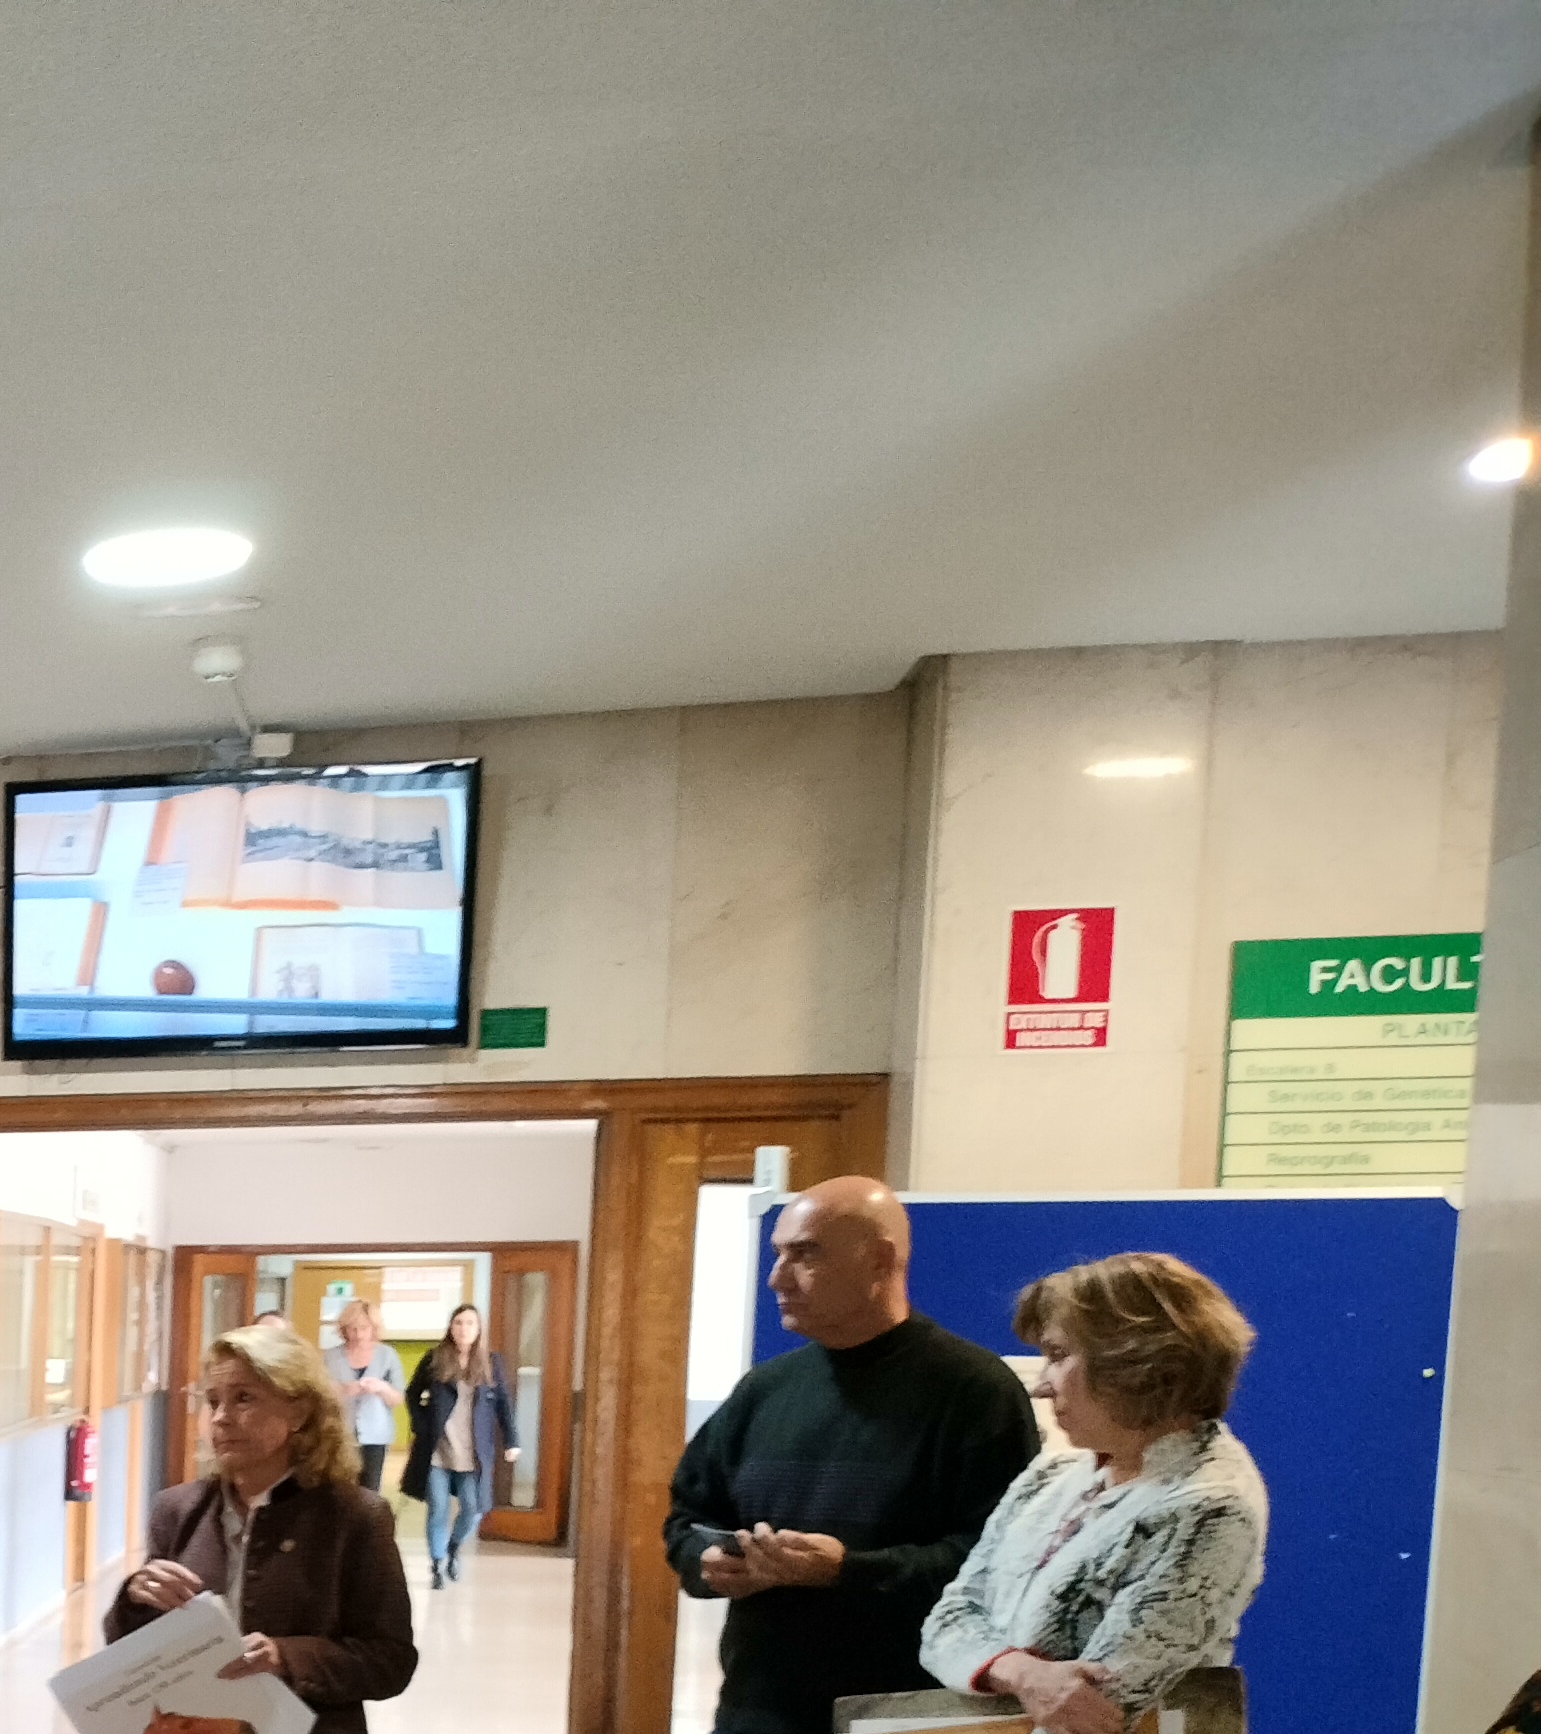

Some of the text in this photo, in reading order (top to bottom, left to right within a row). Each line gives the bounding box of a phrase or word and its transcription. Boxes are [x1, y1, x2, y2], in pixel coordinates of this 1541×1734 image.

[1267, 1089, 1344, 1104] Servicio
[1351, 1088, 1374, 1102] de
[1321, 1121, 1342, 1135] de
